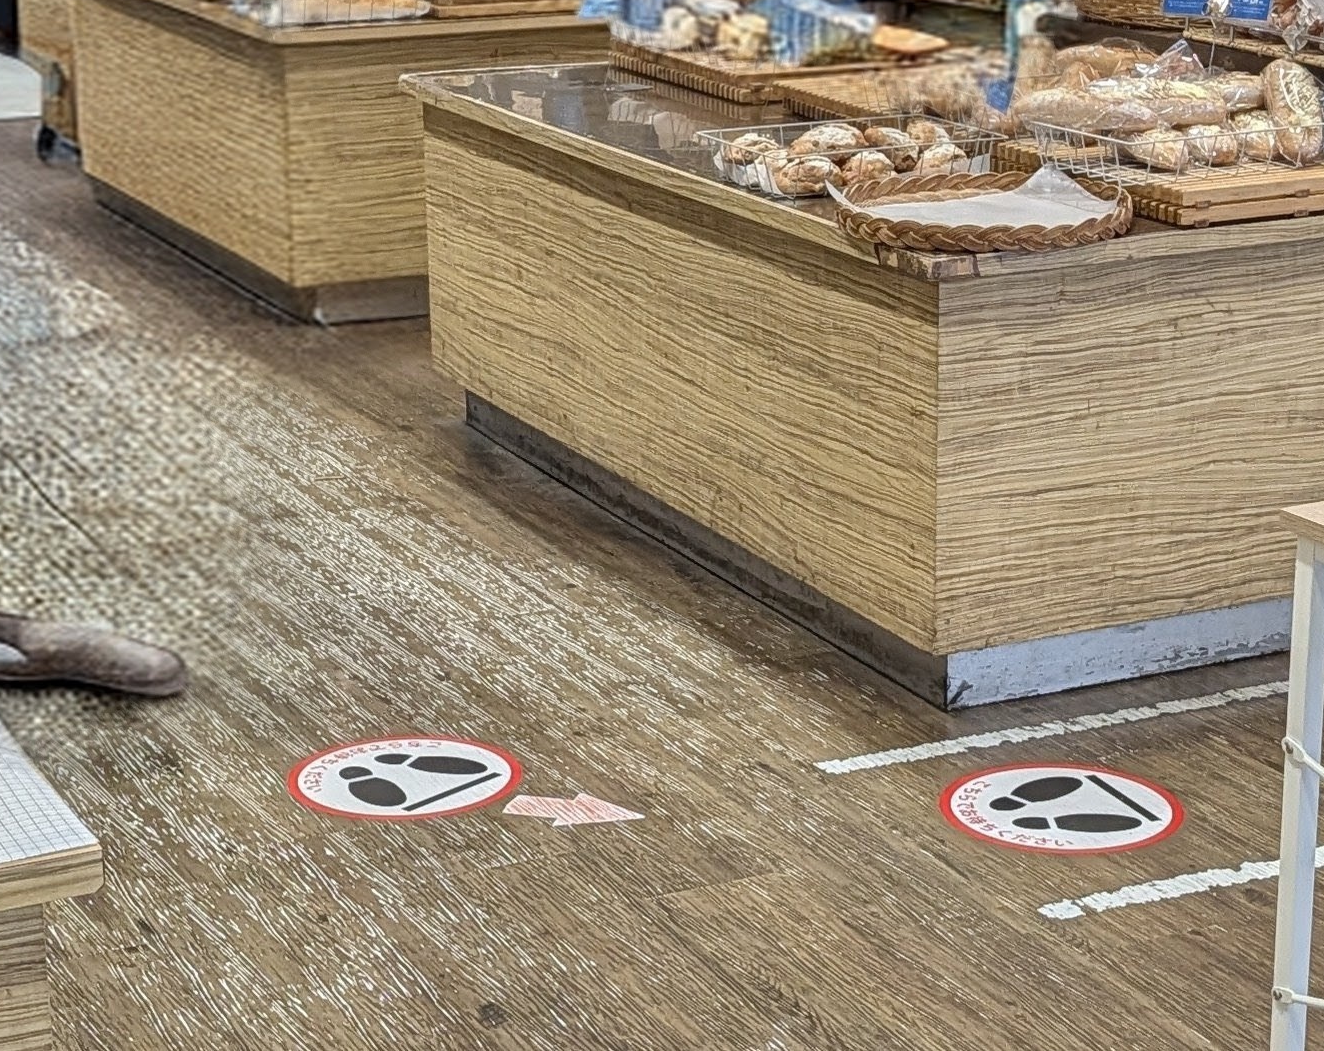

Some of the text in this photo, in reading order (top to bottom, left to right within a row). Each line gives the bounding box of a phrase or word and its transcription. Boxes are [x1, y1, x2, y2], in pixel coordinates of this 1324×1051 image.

[956, 780, 1074, 847] こちらでお待ちください
